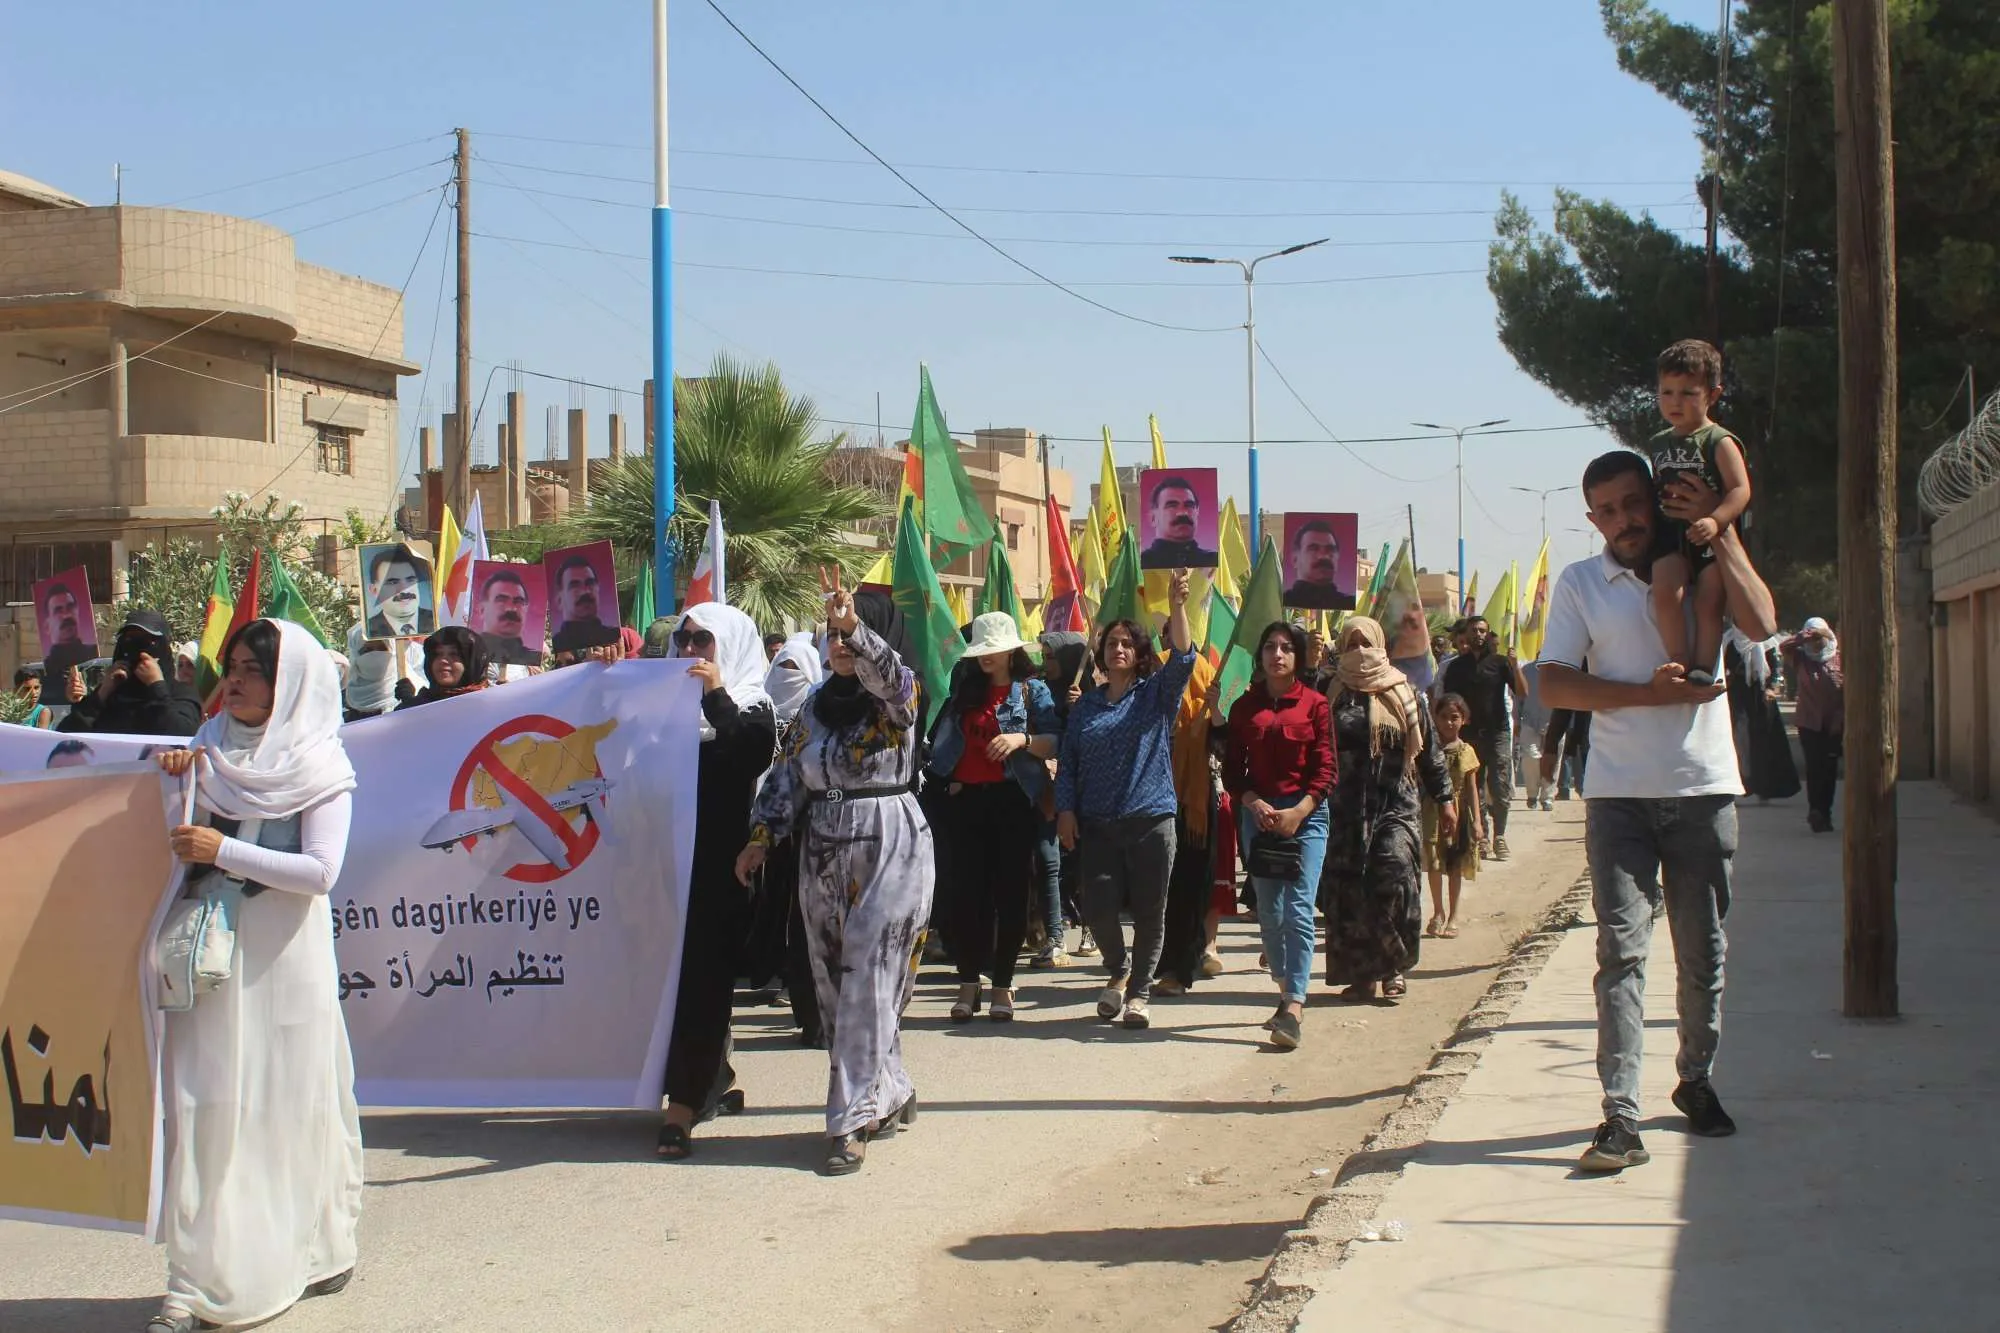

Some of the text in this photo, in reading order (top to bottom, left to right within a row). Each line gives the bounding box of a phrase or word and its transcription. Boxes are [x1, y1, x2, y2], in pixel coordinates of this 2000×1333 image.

[391, 888, 557, 935] dagirkeriyê
[567, 896, 601, 930] ye
[386, 950, 474, 998] المرأة
[486, 949, 565, 1004] تنظيم
